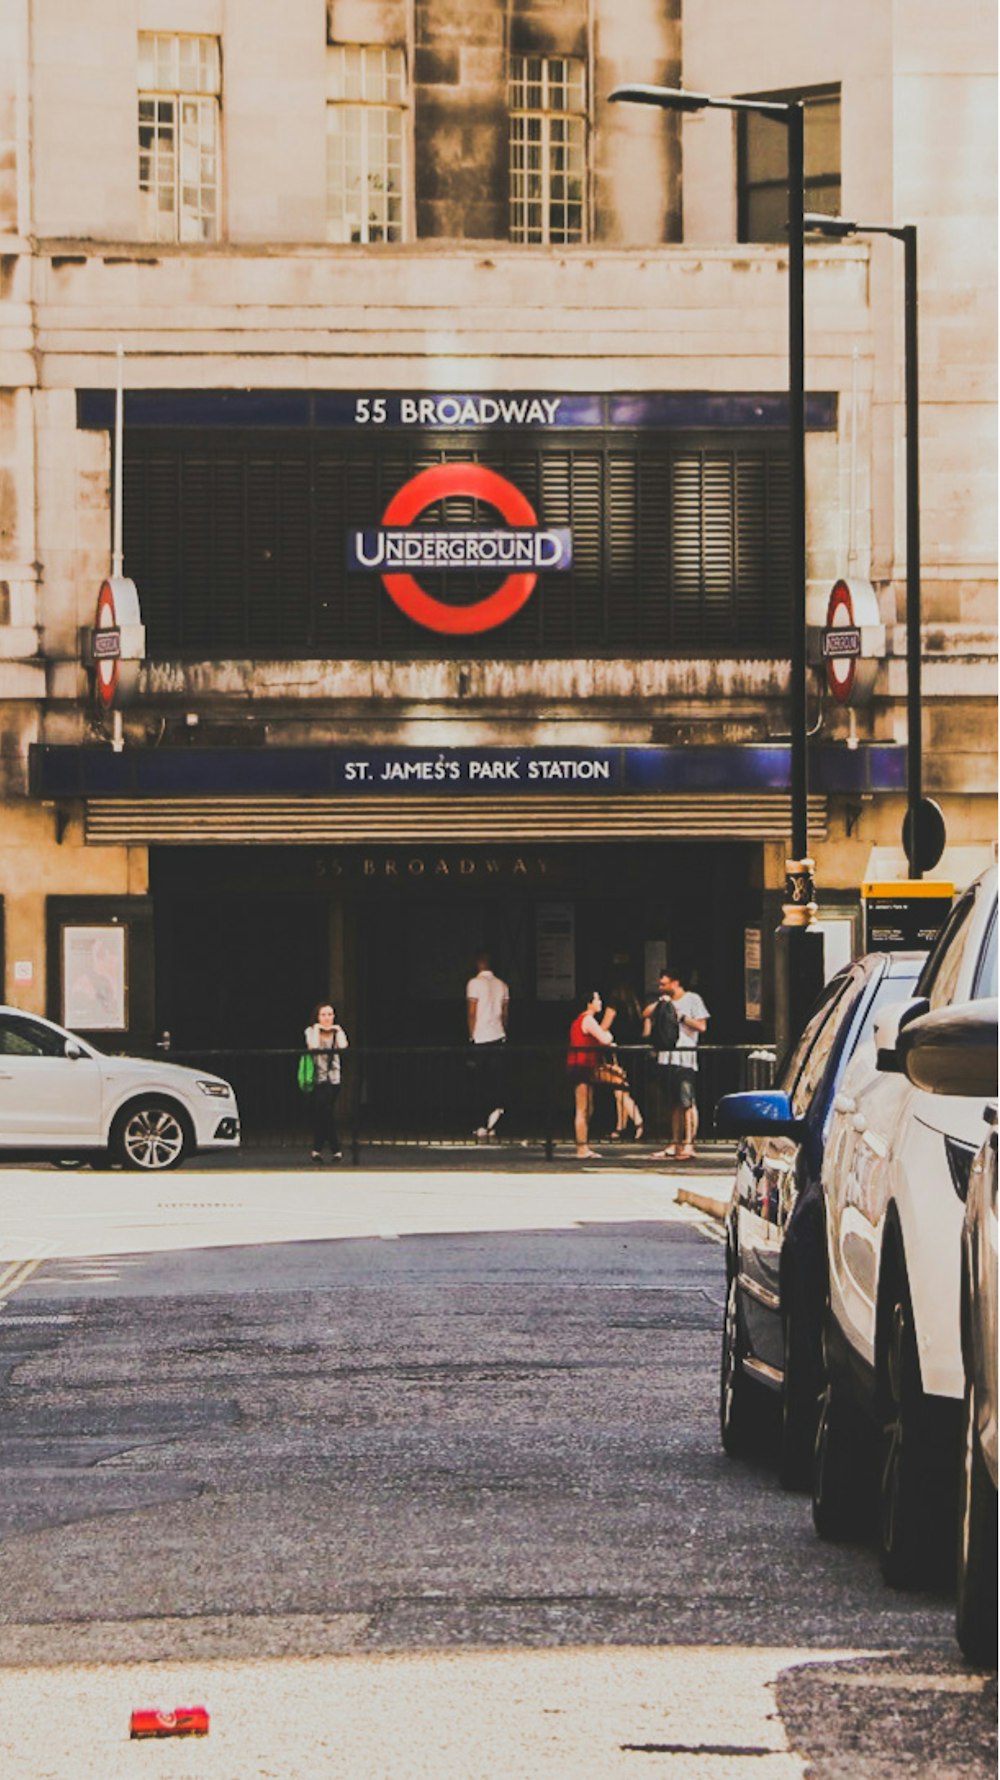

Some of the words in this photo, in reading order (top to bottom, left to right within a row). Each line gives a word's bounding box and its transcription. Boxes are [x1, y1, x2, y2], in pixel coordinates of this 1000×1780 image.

[355, 399, 386, 423] 55
[401, 399, 561, 423] BROADWAY
[356, 532, 562, 566] UNDERGROUND
[345, 763, 373, 780] ST.
[381, 762, 460, 780] JAMES'S
[469, 761, 520, 779] PARK
[528, 761, 609, 779] STATION
[363, 859, 549, 875] BROADWAY
